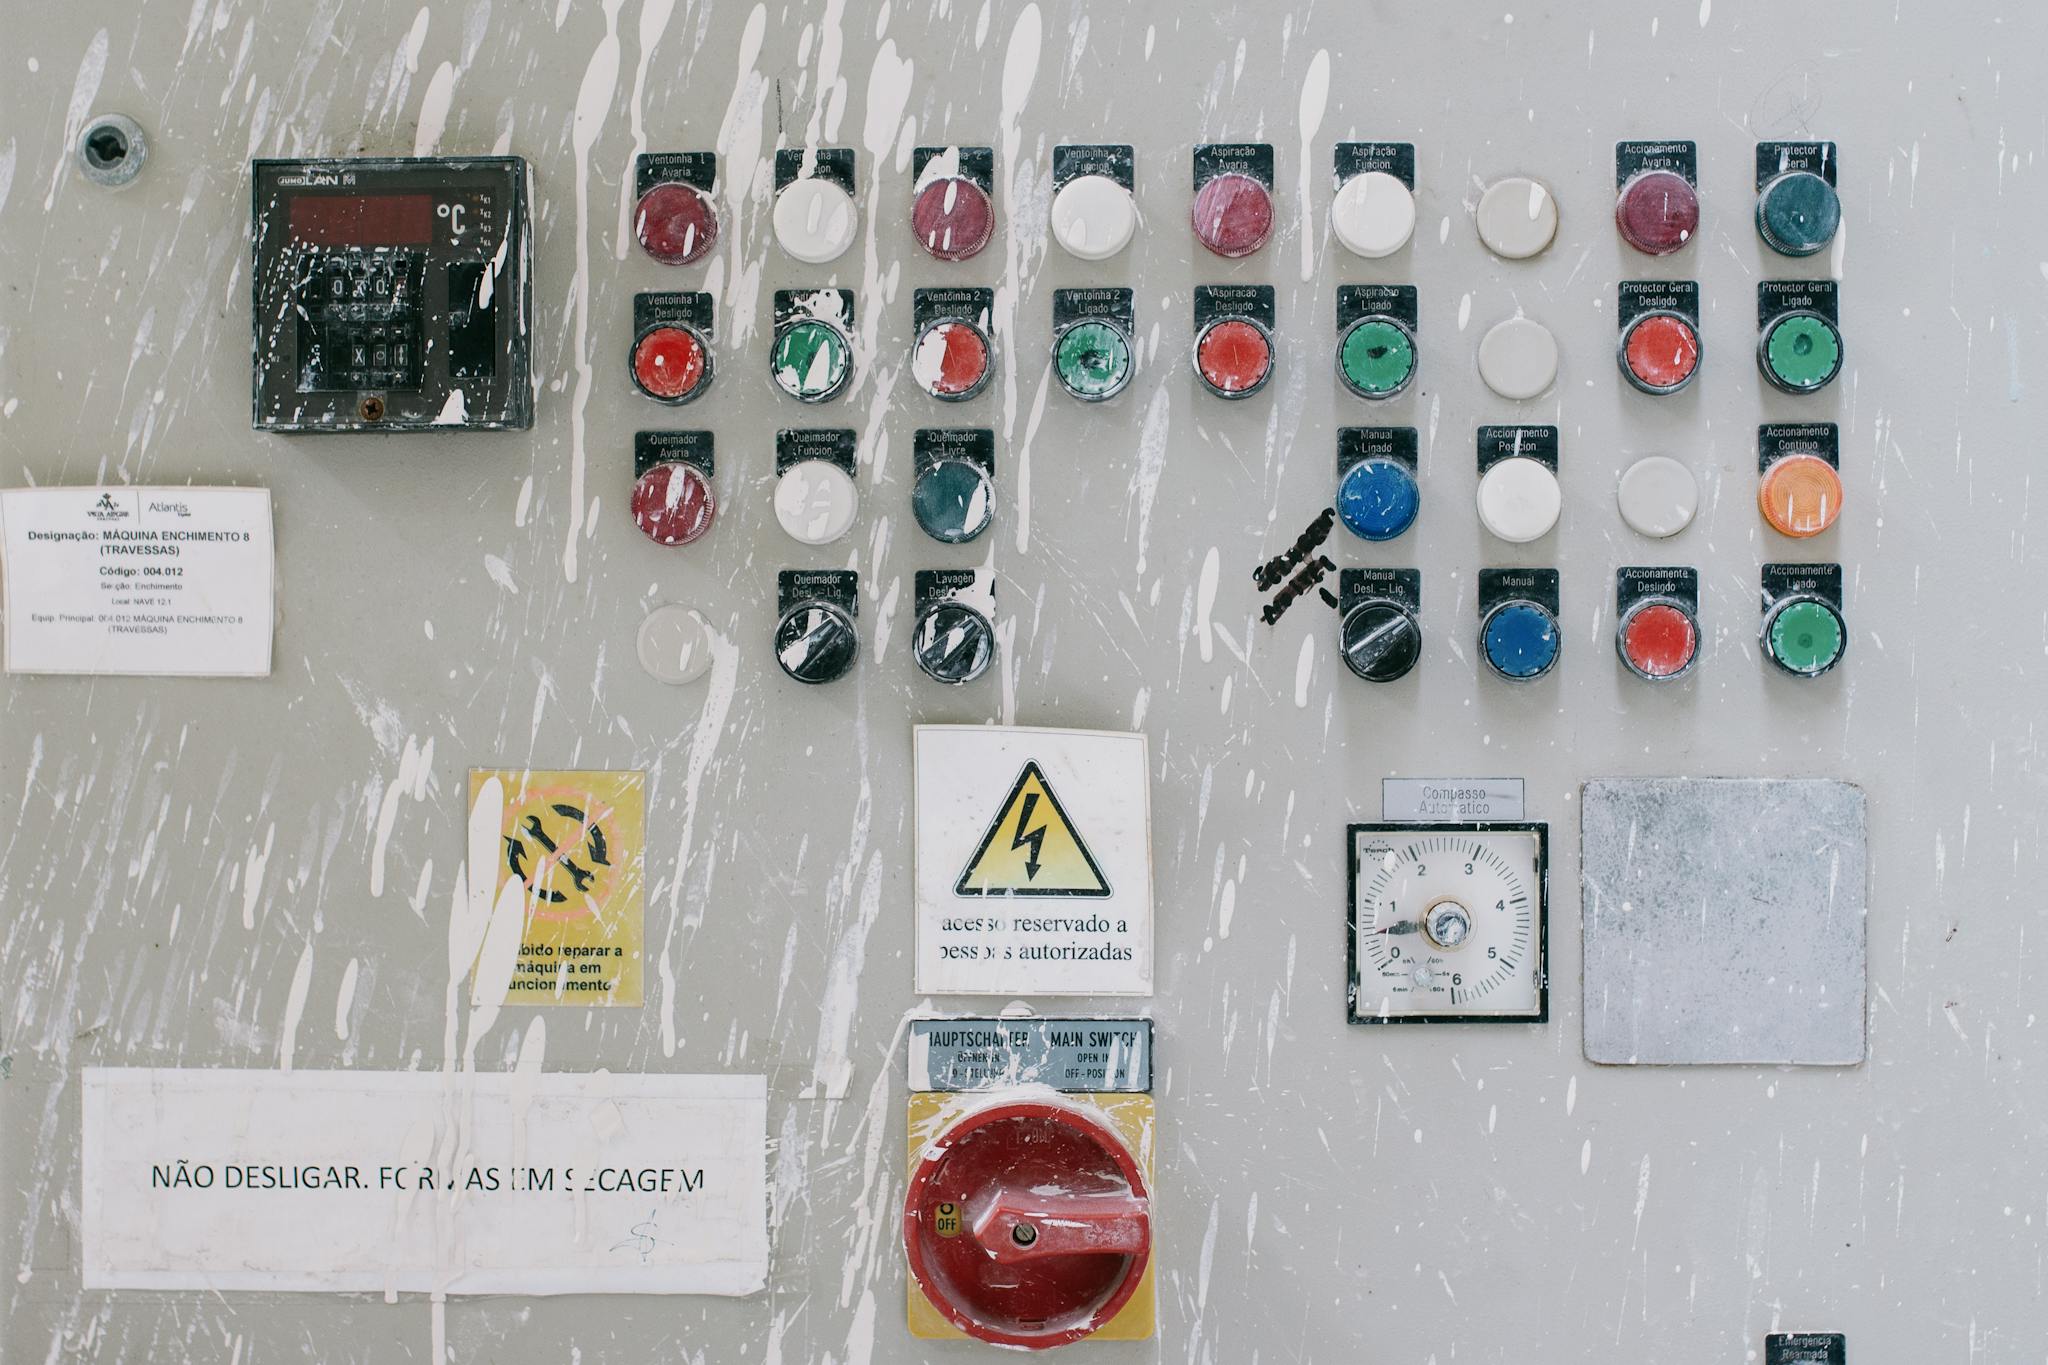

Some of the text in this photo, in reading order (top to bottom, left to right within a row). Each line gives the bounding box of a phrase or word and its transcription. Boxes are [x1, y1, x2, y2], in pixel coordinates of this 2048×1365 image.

[1115, 147, 1123, 158] 2
[1210, 145, 1256, 158] Aspiração
[1624, 144, 1688, 155] Accionamento
[647, 153, 693, 166] Ventoinha
[1218, 159, 1249, 170] Avaria
[1641, 156, 1671, 168] Avaria
[661, 166, 692, 178] Avaria
[436, 203, 466, 235] °C
[1622, 282, 1693, 293] Protector Geral
[1762, 283, 1832, 293] Protector Geral
[647, 294, 692, 306] Ventoinha
[926, 291, 981, 303] Ventoinha 2
[1066, 290, 1121, 302] Ventoinha 2
[1638, 295, 1678, 308] Desligdo
[1782, 295, 1813, 308] Ligado
[1078, 304, 1109, 316] Ligado
[1215, 301, 1254, 313] Desligdo
[1361, 300, 1393, 311] Ligado
[792, 431, 840, 443] Queimador
[929, 431, 978, 443] Queimador
[1361, 429, 1394, 440] Manual
[1486, 427, 1550, 438] Accionmento
[1766, 426, 1830, 437] Accionamento
[649, 434, 698, 446] Queimador
[1778, 440, 1819, 451] Continuo
[659, 447, 689, 458] Avaria
[941, 444, 967, 456] Livre
[1361, 442, 1394, 454] Ligado
[1498, 441, 1537, 452] Poscion
[148, 501, 189, 514] Atlantis
[28, 528, 250, 543] Designação: MÁQUINA ENCHIMENTO 8
[99, 545, 180, 557] (TRAVESSAS)
[99, 566, 184, 577] Código: 004.012
[1363, 570, 1396, 581] Manual
[793, 573, 842, 585] Queimador
[1502, 576, 1535, 587] Manual
[134, 582, 183, 591] Enchimento
[1388, 583, 1407, 596] Lig.
[1637, 581, 1676, 593] Desligdo
[133, 613, 175, 624] MÁQUINA
[1423, 786, 1486, 802] Compasso
[1418, 801, 1490, 815] Autoatico
[1417, 864, 1427, 877] 2
[1464, 863, 1474, 876] 3
[1389, 901, 1397, 912] 1
[1495, 899, 1505, 911] 4
[942, 914, 1128, 933] acesso reservado a
[558, 946, 611, 959] reparar
[614, 947, 623, 957] a
[1018, 941, 1133, 961] autorizadas
[1390, 947, 1401, 959] 0
[1487, 947, 1497, 959] 5
[515, 962, 602, 975] máquia em
[1452, 973, 1463, 986] 6
[1050, 1031, 1083, 1048] MAIN
[1077, 1053, 1098, 1063] OPEN
[152, 1159, 215, 1189] NÃO
[225, 1165, 369, 1190] DESLIGAR.
[937, 1218, 957, 1231] OFF
